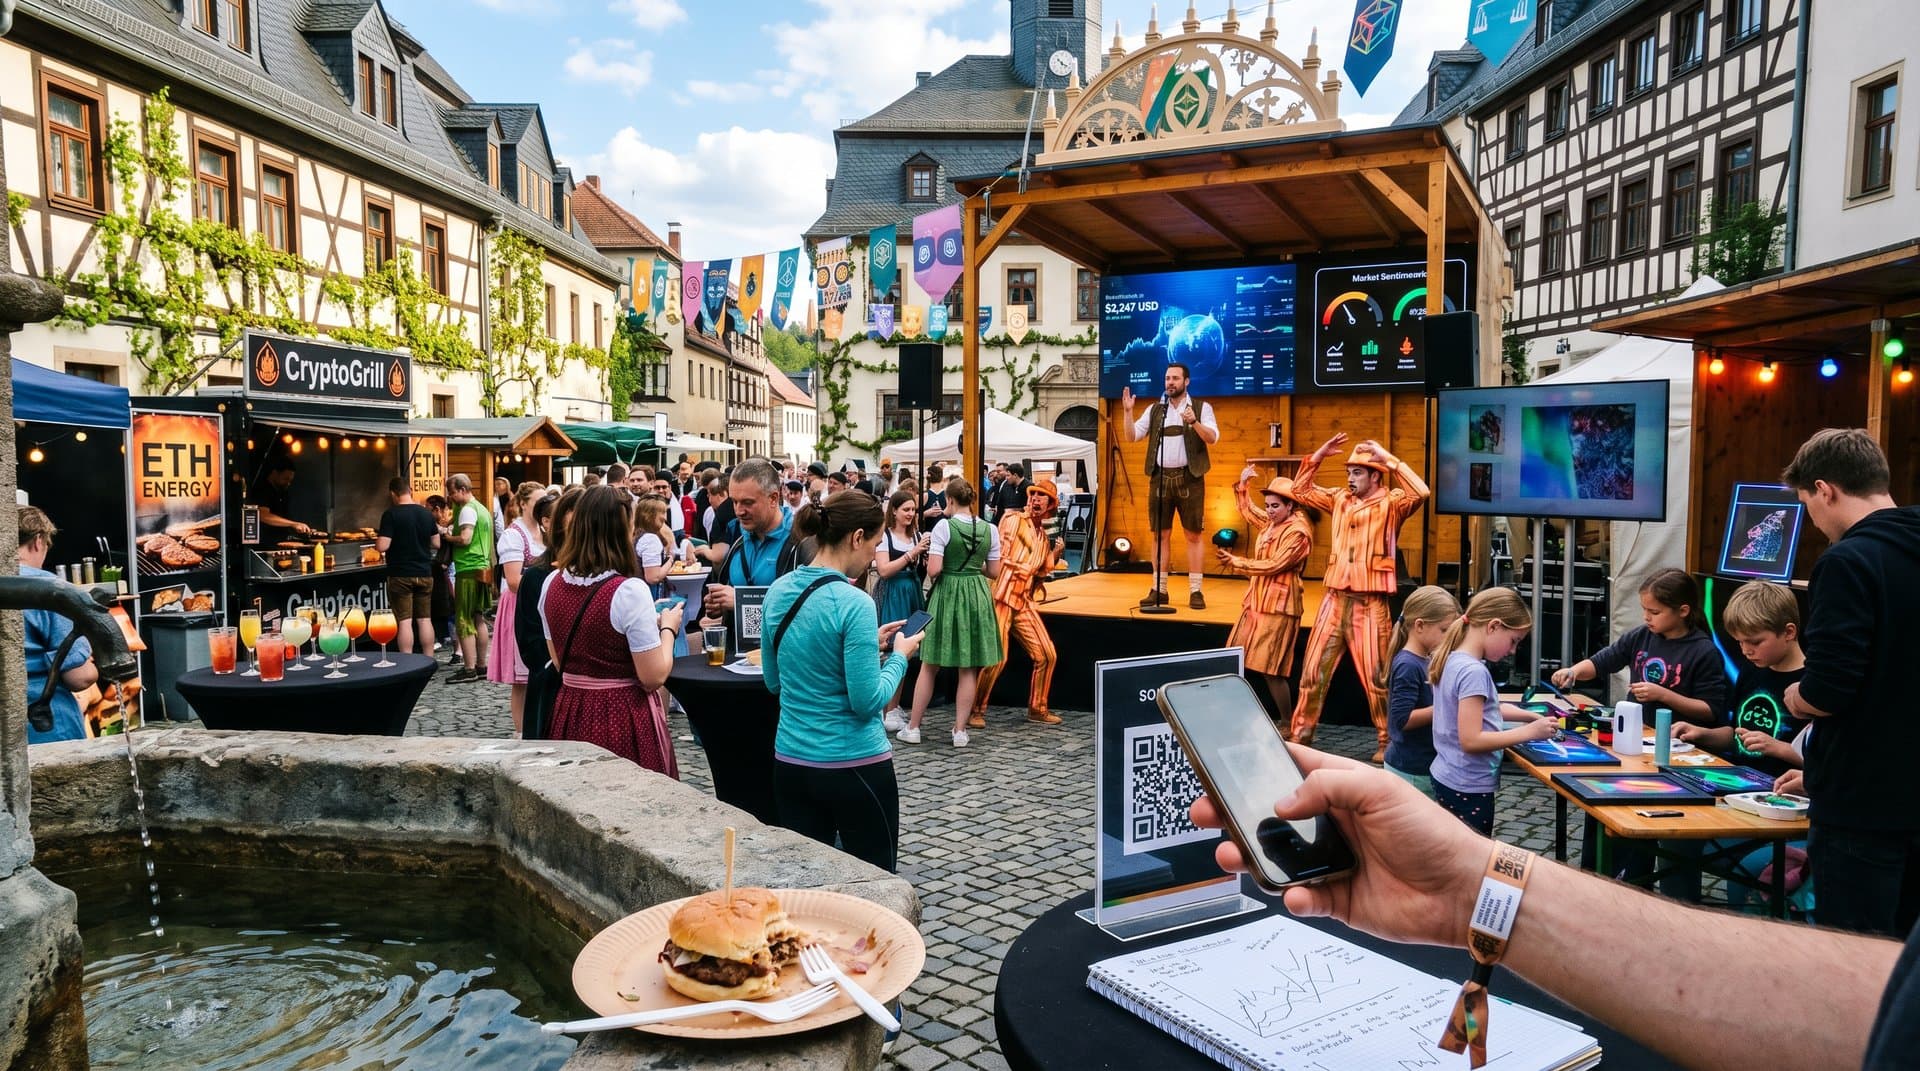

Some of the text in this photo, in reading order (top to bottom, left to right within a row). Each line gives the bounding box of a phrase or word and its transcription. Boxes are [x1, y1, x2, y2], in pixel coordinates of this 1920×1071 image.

[1352, 272, 1380, 283] Market
[1105, 301, 1159, 315] $2,247 USD
[285, 351, 384, 390] CryptoGrill
[142, 442, 212, 478] ETH
[414, 453, 442, 478] ETH
[143, 481, 212, 498] ENERGY
[414, 479, 443, 492] ENERGY
[1139, 688, 1158, 702] SO
